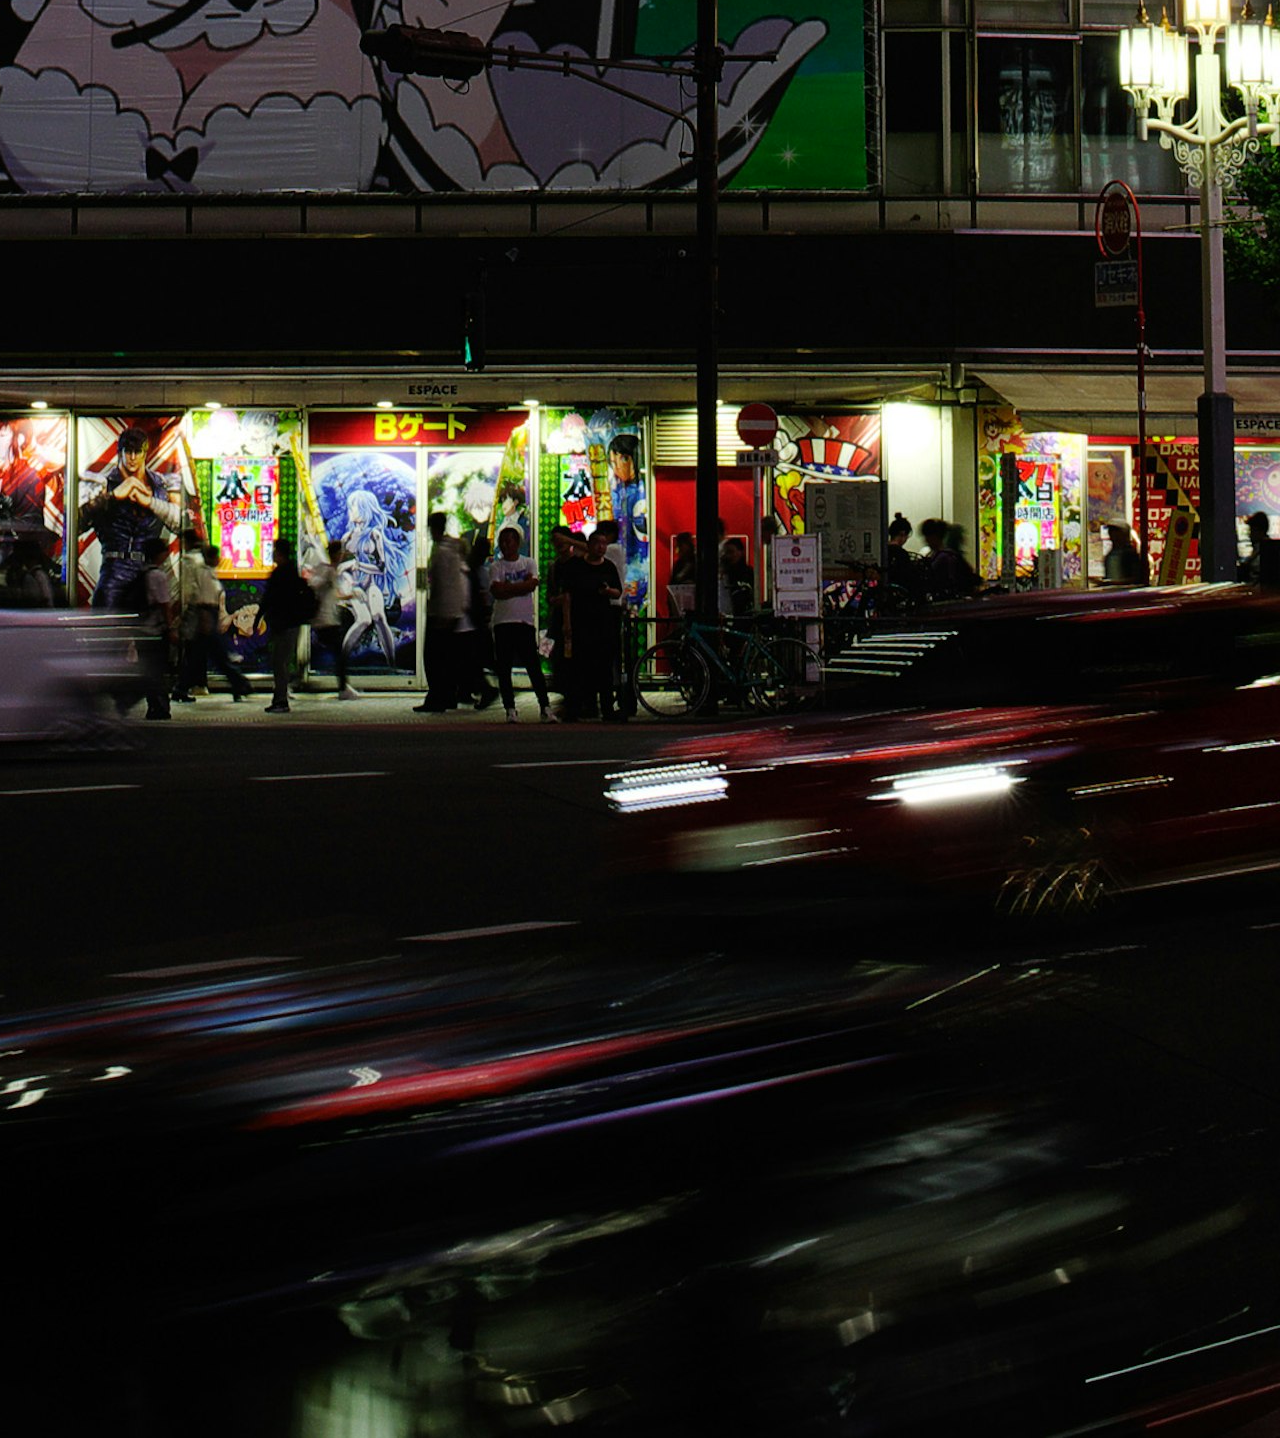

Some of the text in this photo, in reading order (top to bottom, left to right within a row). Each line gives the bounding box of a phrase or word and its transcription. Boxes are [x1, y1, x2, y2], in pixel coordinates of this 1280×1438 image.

[407, 384, 459, 395] ESPACE
[373, 412, 467, 442] Bゲート
[215, 469, 272, 504] 本日
